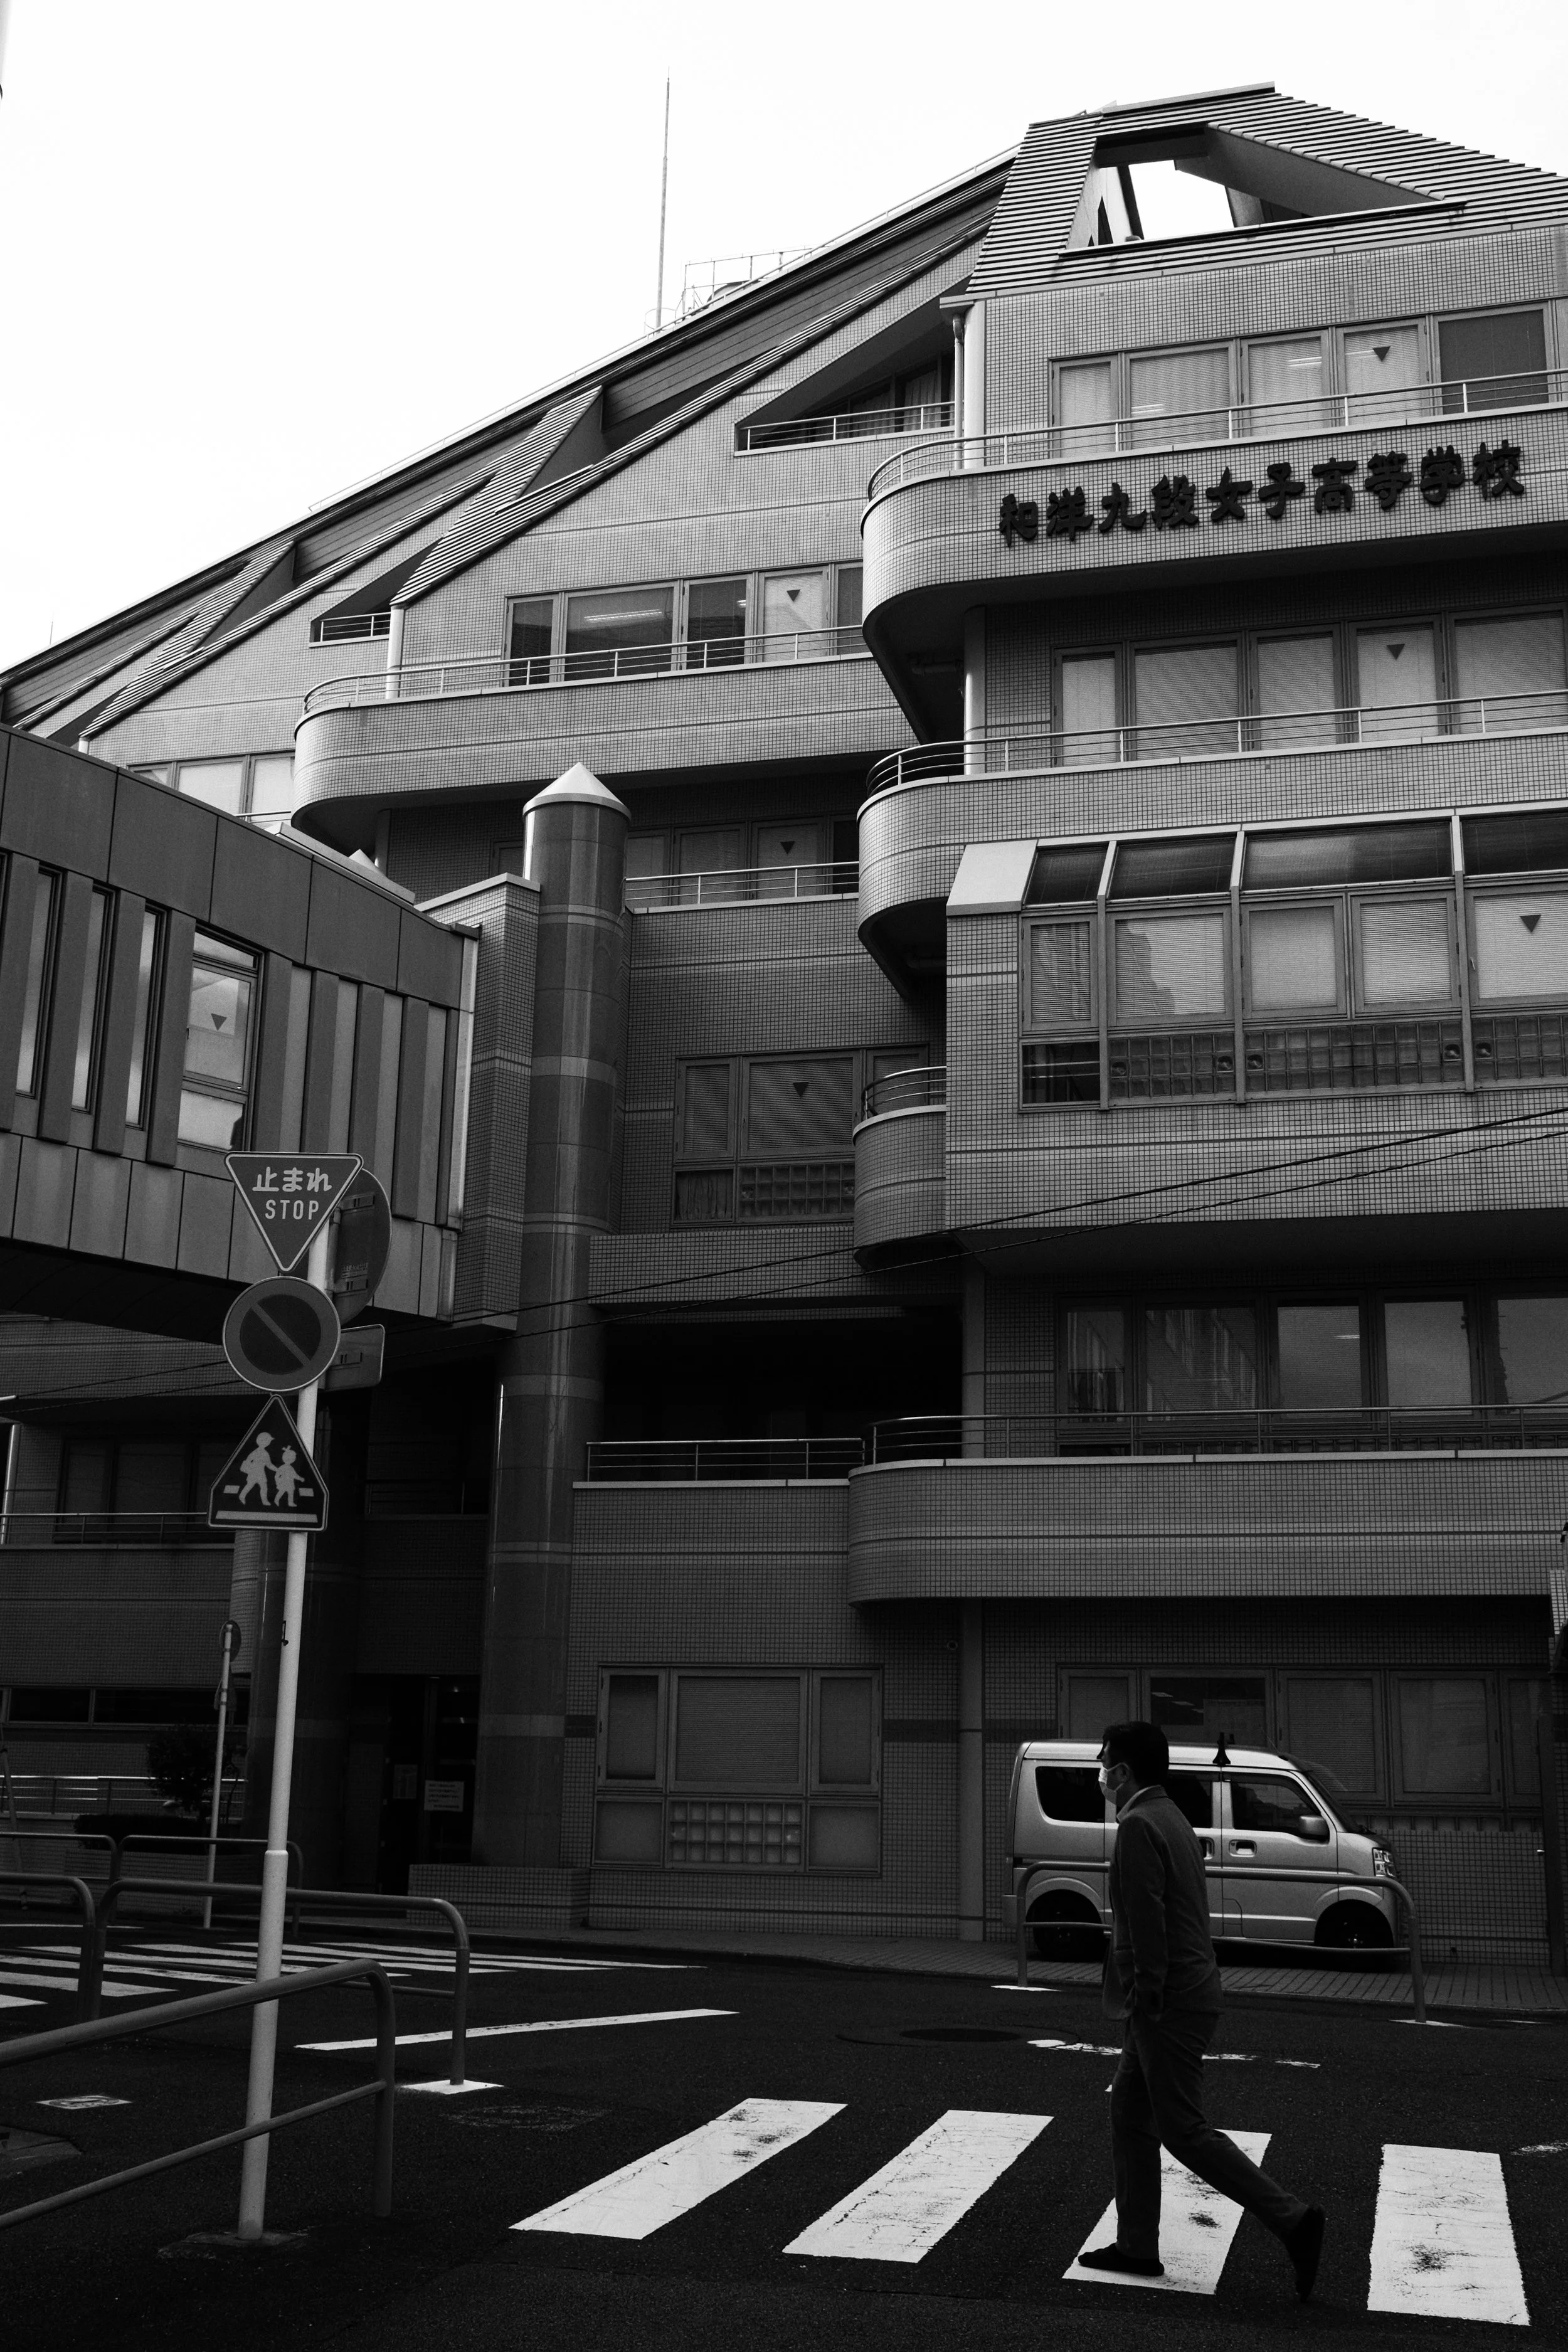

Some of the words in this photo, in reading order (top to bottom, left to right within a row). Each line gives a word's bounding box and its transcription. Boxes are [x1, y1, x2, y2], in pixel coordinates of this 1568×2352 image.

[999, 439, 1525, 546] 和洋九段女子高等学校
[252, 1166, 332, 1193] 止まれ
[265, 1199, 319, 1221] STOP
